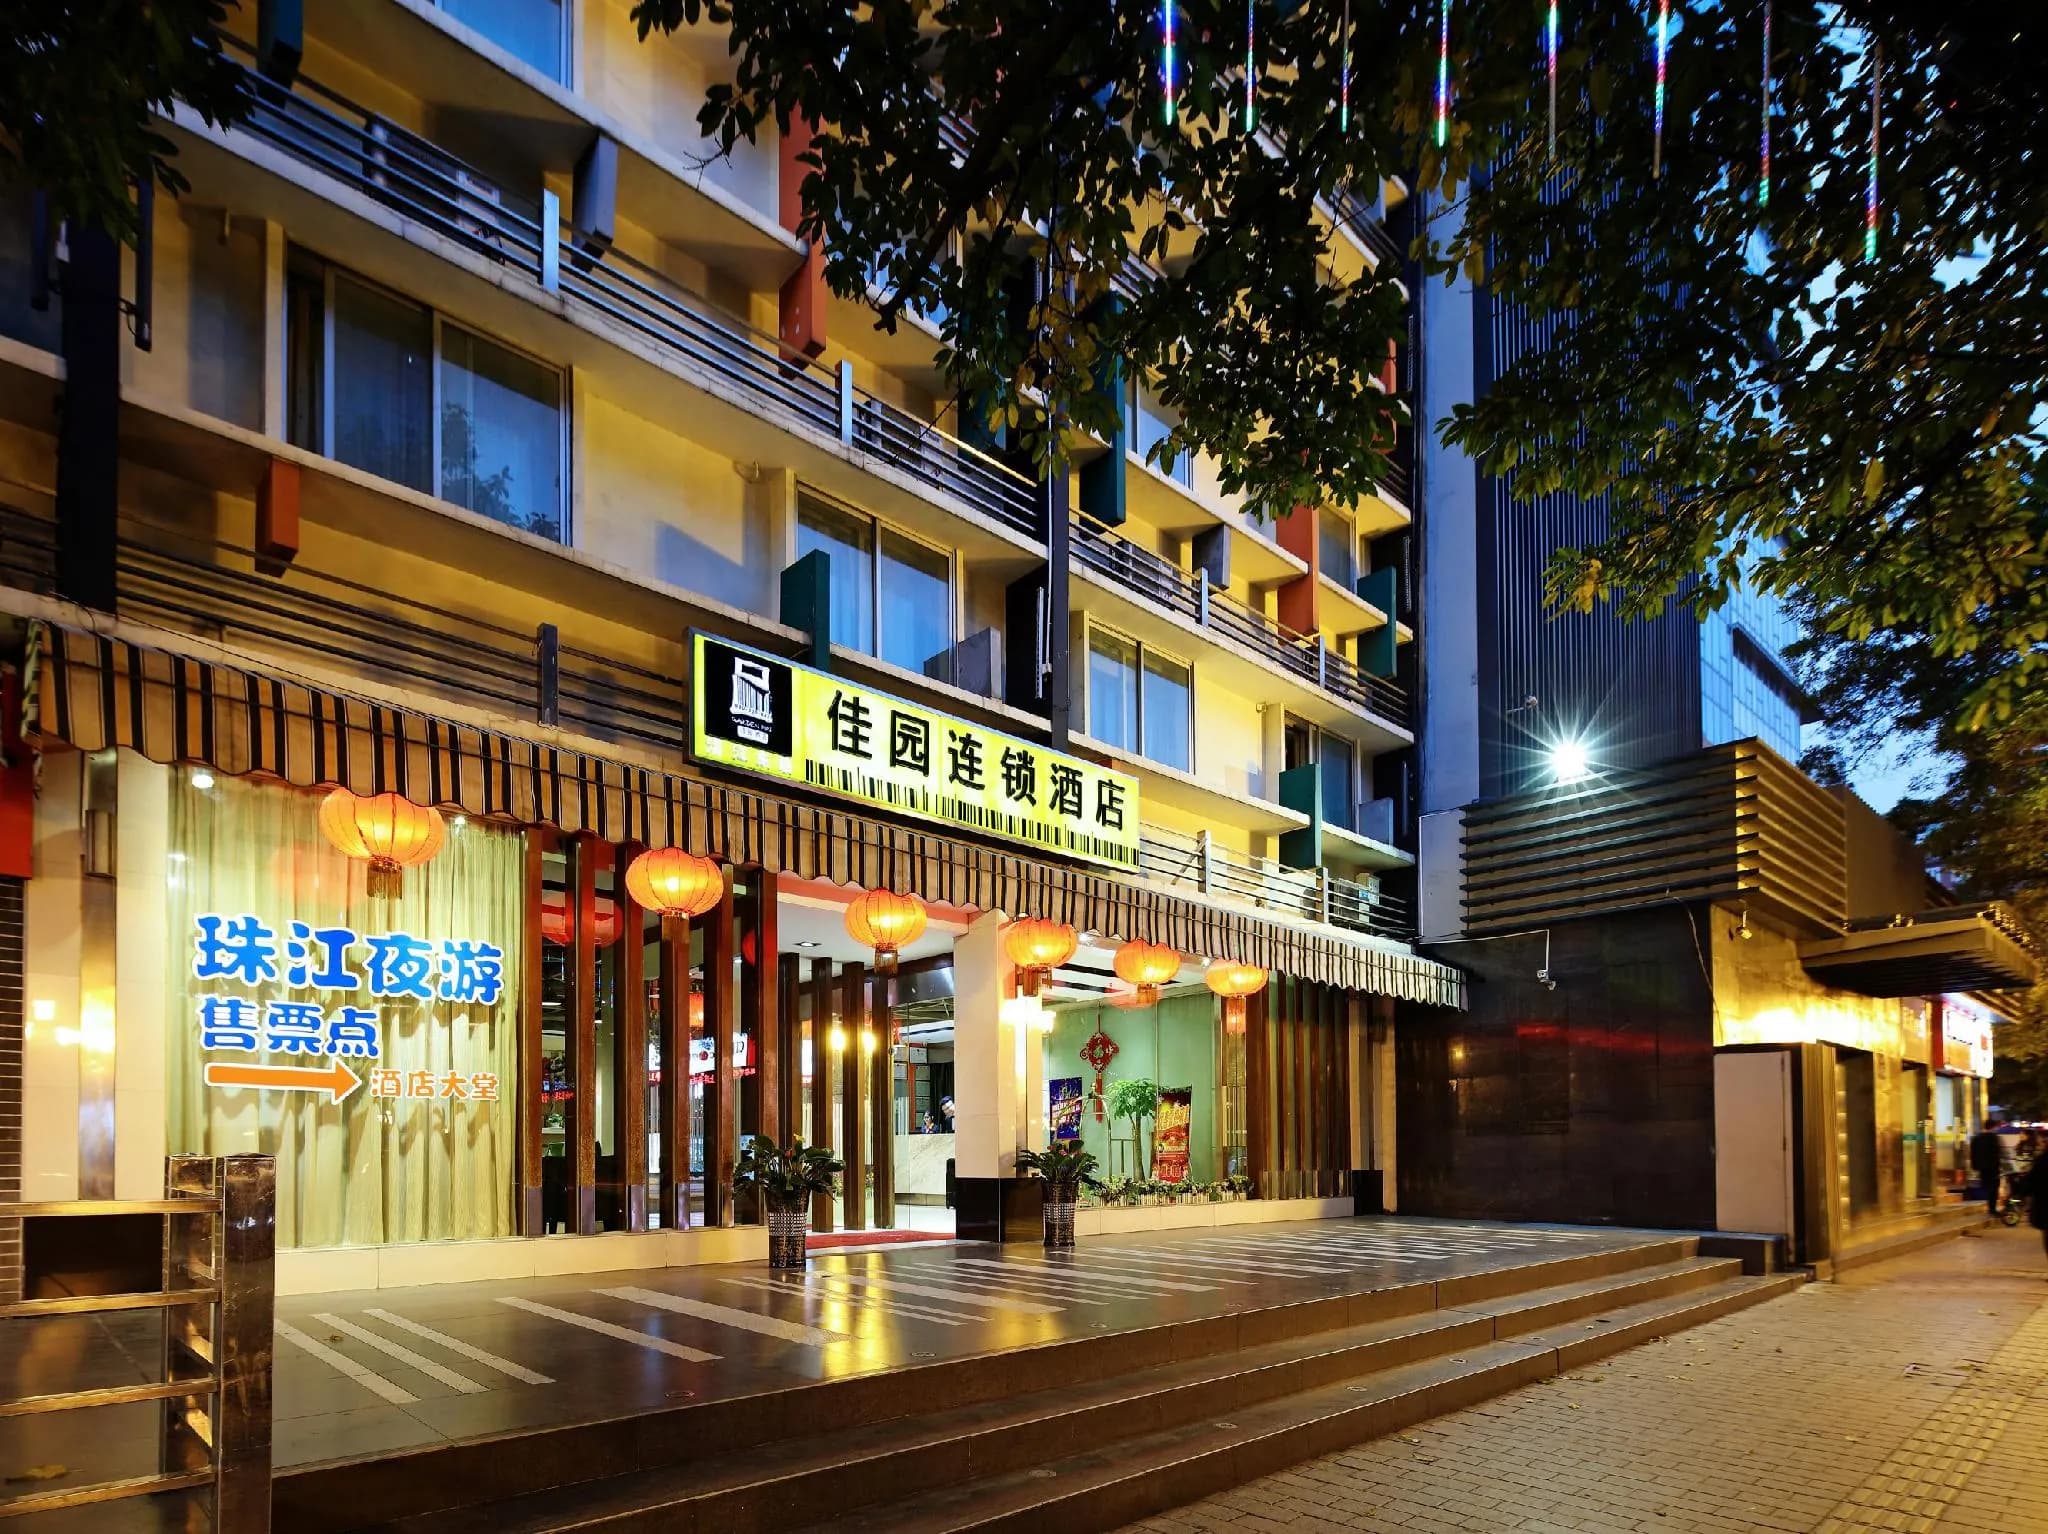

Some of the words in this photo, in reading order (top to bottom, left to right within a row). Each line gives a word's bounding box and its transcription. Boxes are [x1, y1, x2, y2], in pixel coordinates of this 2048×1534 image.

[827, 690, 1126, 831] 佳园连锁酒店
[194, 914, 504, 1005] 珠江夜游
[199, 996, 382, 1058] 售票点
[369, 1069, 499, 1101] 酒店大堂
